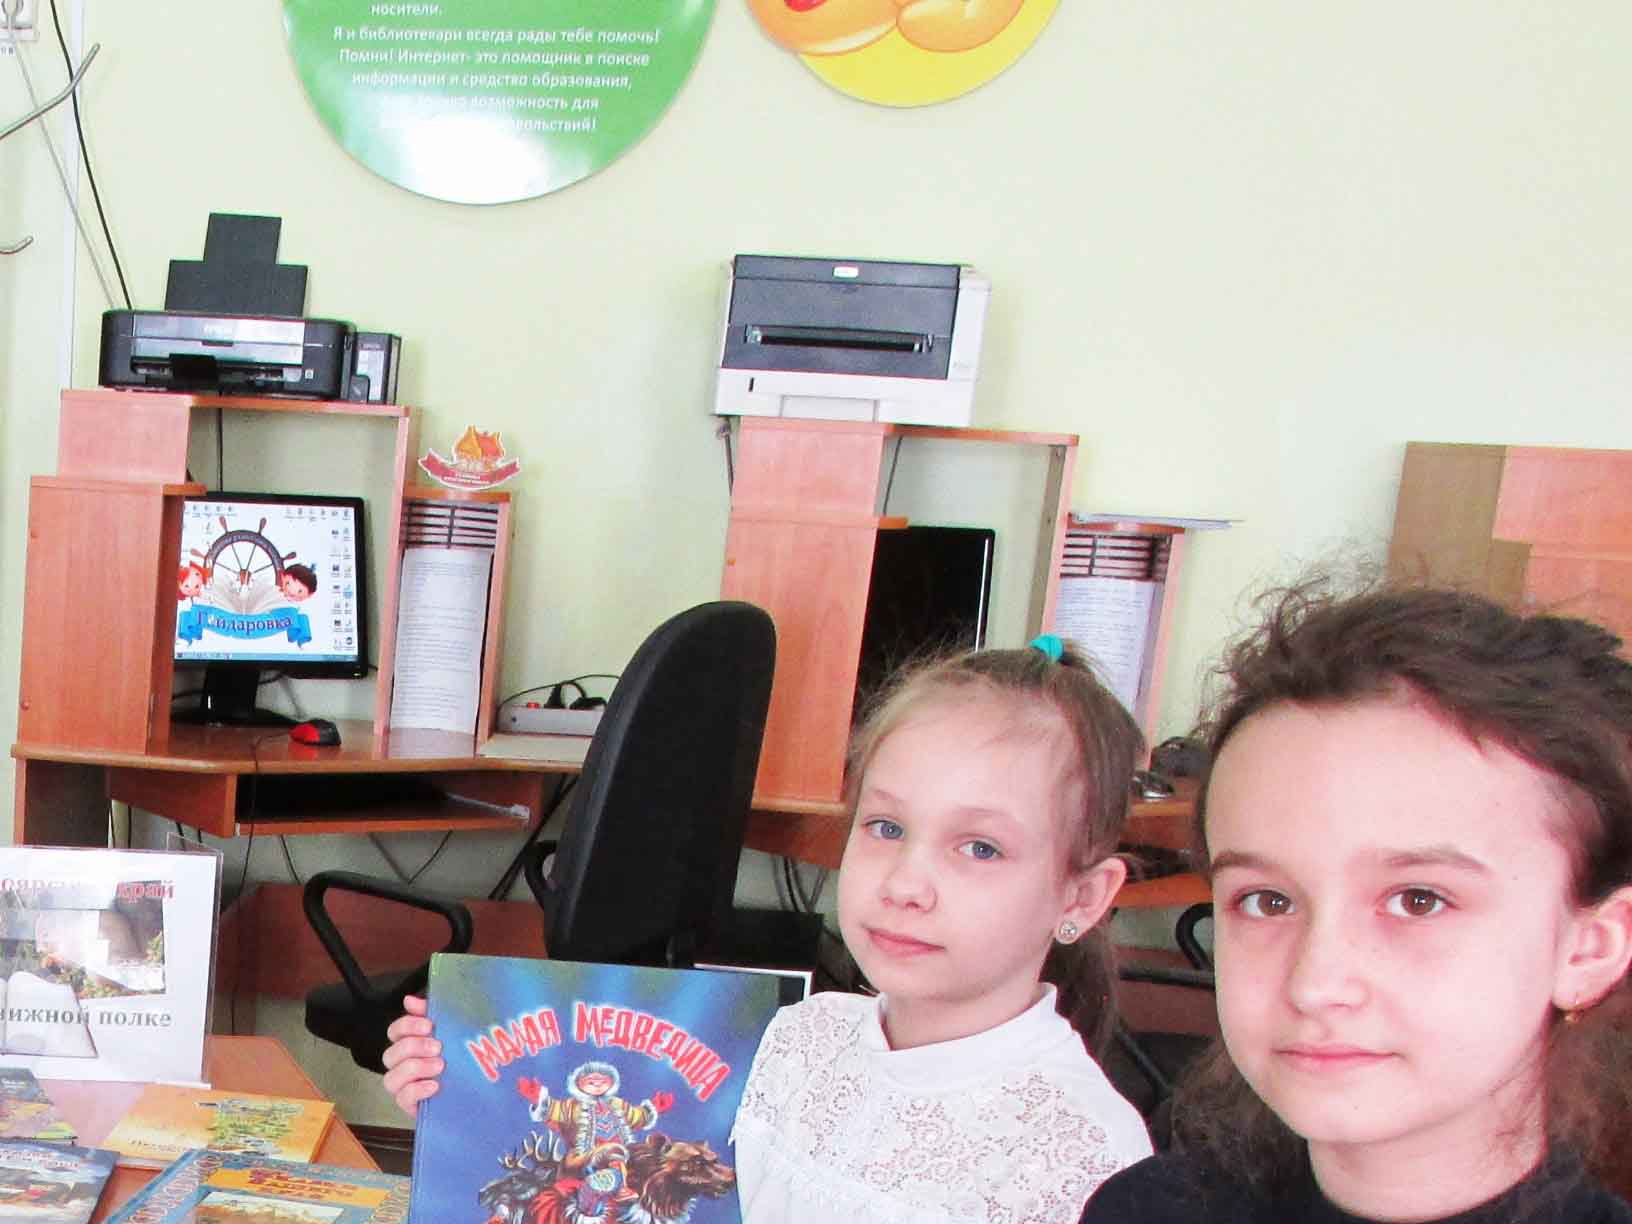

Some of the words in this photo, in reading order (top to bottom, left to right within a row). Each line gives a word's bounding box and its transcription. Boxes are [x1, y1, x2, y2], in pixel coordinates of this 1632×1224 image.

[333, 27, 343, 40] Я
[347, 29, 356, 40] и
[359, 26, 462, 45] библиотекари
[466, 29, 514, 44] всегда
[517, 30, 557, 45] рады
[560, 29, 593, 43] тебе
[597, 27, 660, 44] помочь!
[339, 48, 393, 63] Помни!
[476, 52, 498, 64] это
[502, 52, 581, 69] помощник
[598, 53, 650, 67] поиске
[352, 71, 447, 91] информации
[462, 74, 528, 90] средство
[532, 73, 632, 90] образования,
[572, 98, 599, 112] для
[99, 1009, 172, 1027] полке
[468, 1006, 561, 1081] МАЛАЯ
[575, 1003, 731, 1101] МЕДВЕДИЦА
